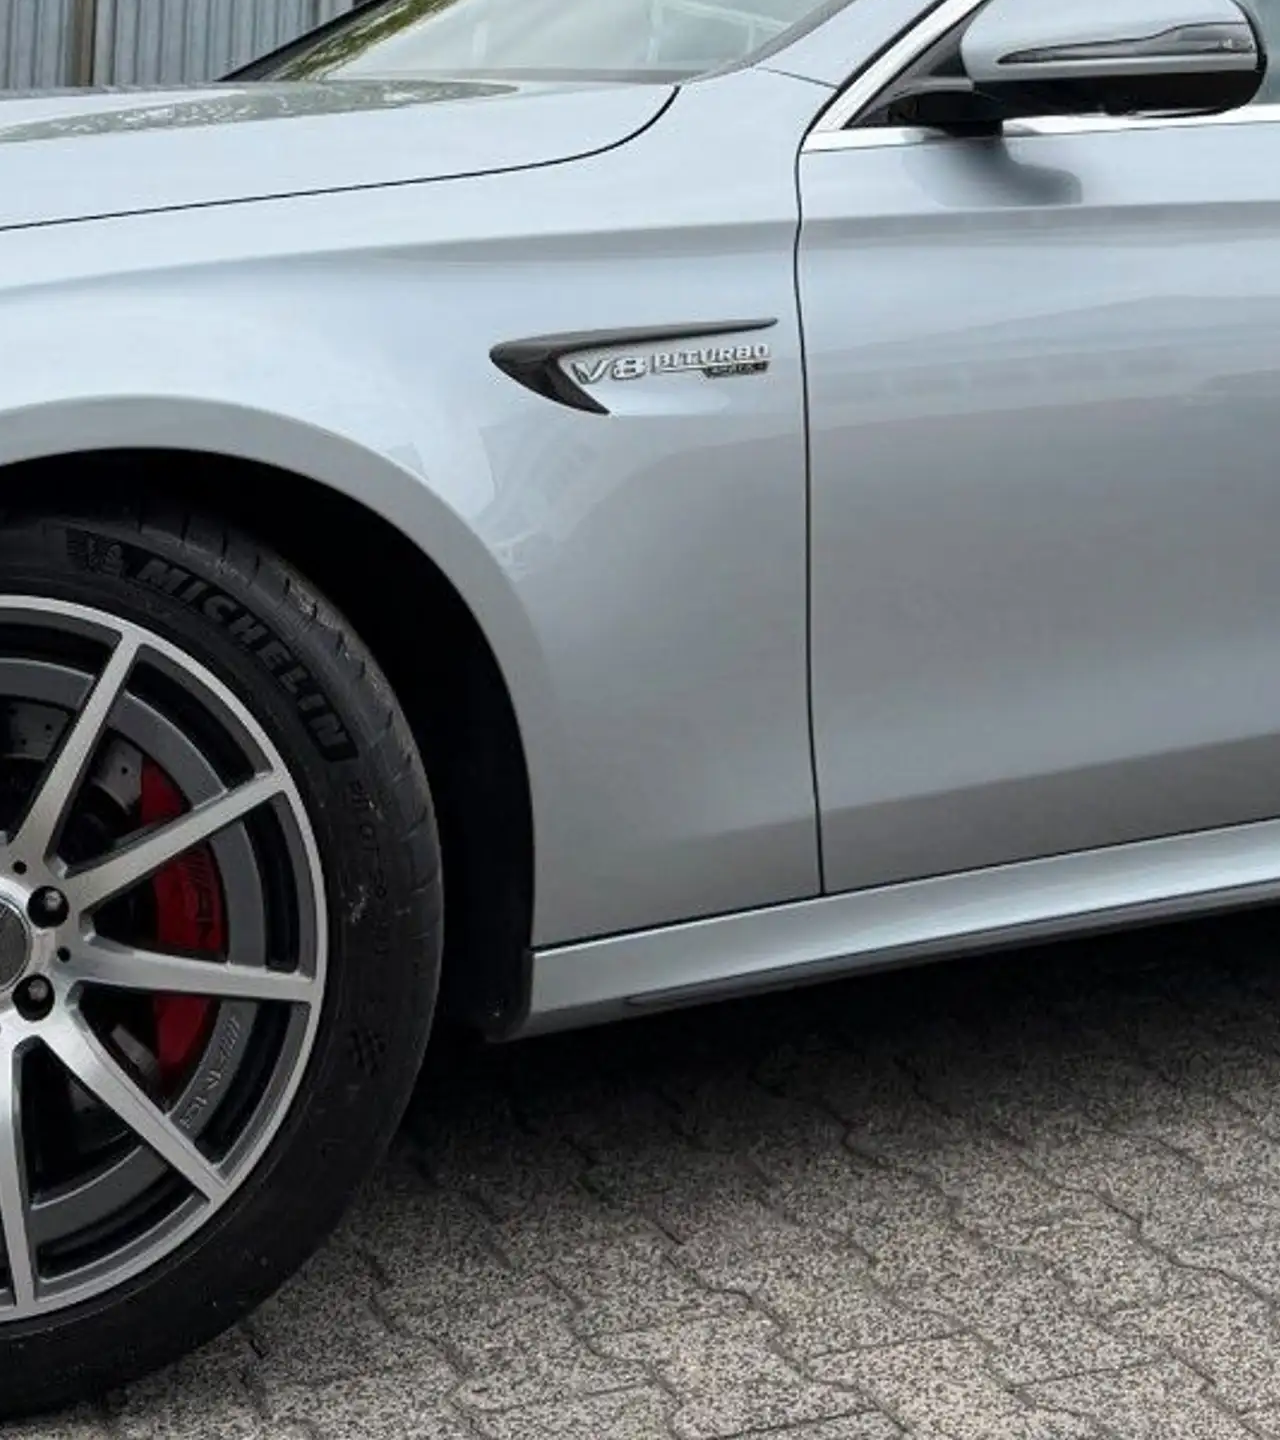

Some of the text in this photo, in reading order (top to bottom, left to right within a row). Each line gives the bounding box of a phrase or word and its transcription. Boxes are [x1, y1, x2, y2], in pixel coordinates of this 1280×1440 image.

[570, 357, 649, 384] V8
[651, 343, 770, 370] BITURBO
[138, 556, 353, 756] MICHELIN
